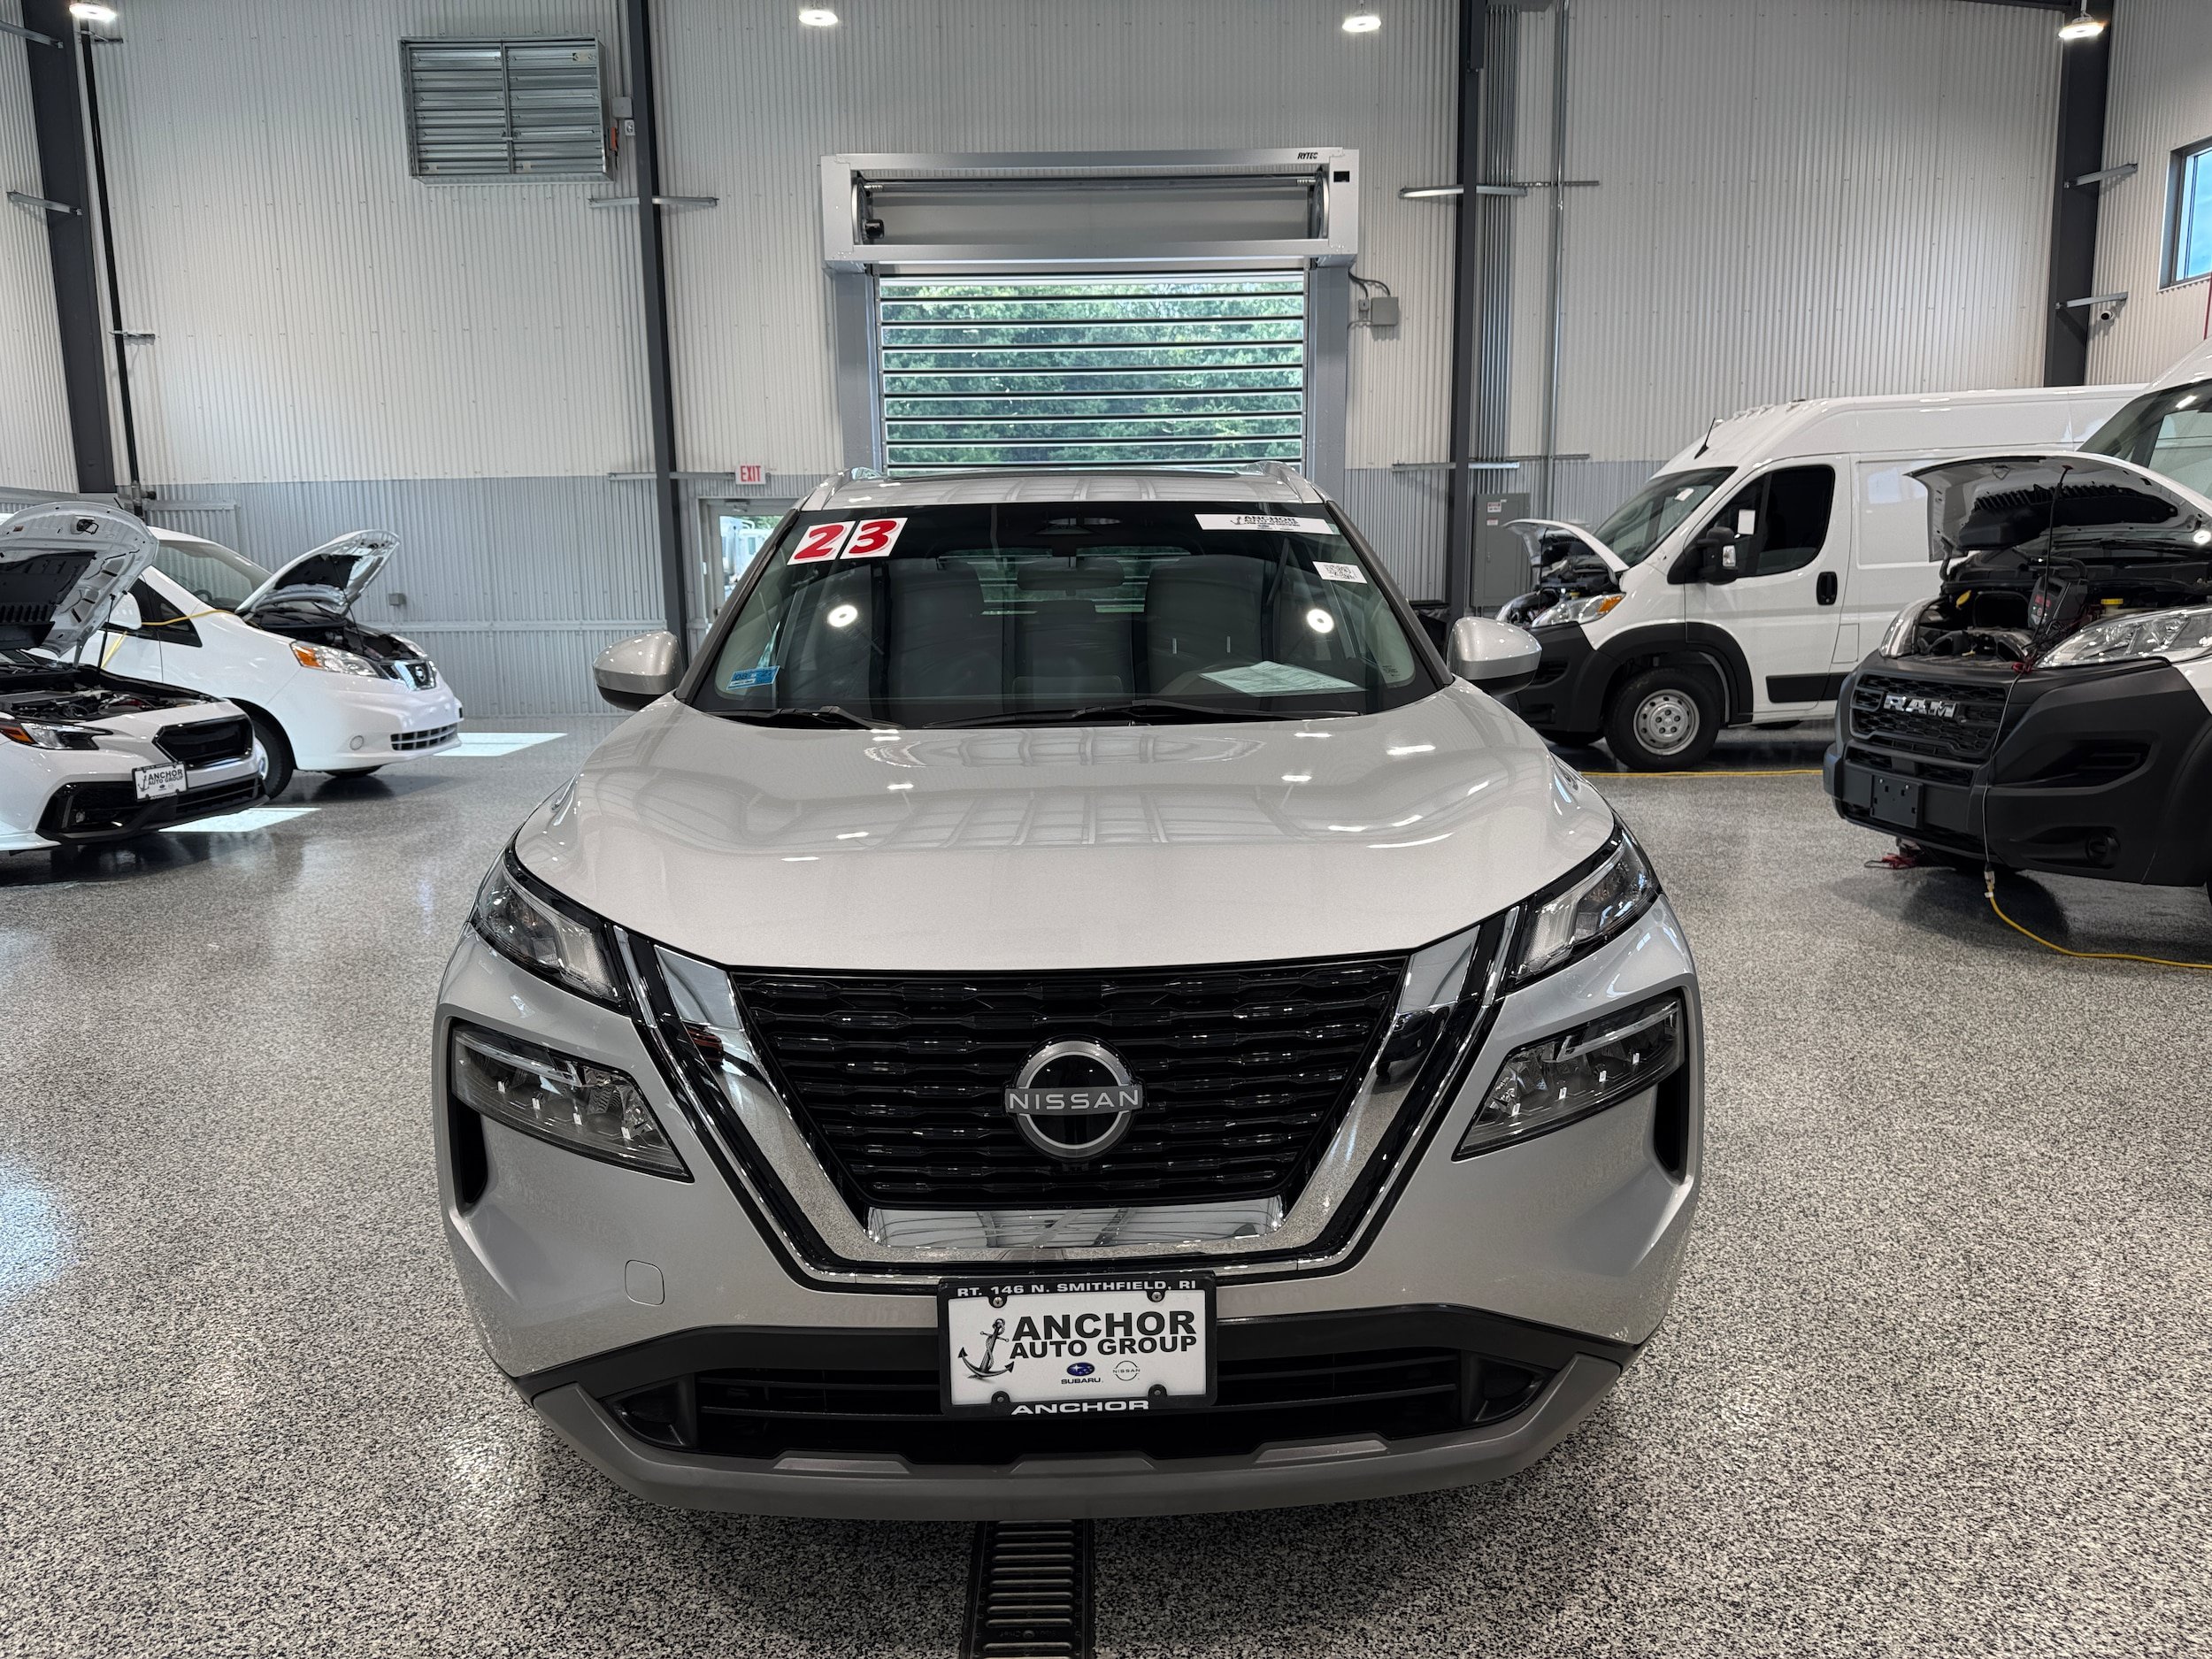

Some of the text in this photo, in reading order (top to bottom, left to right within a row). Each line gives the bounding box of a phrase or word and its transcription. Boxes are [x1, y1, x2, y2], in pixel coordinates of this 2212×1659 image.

[740, 465, 761, 482] EXIT
[794, 520, 898, 560] 23
[1883, 694, 1956, 718] RAM
[149, 769, 183, 780] ANCHOR
[1009, 1089, 1139, 1110] NISSAN
[957, 1280, 1196, 1297] RT. 146 N. SMITHFIELD, RI
[1012, 1310, 1197, 1341] ANCHOR
[1010, 1335, 1197, 1359] AUTO GROUP
[1010, 1400, 1149, 1416] ANCHOR
